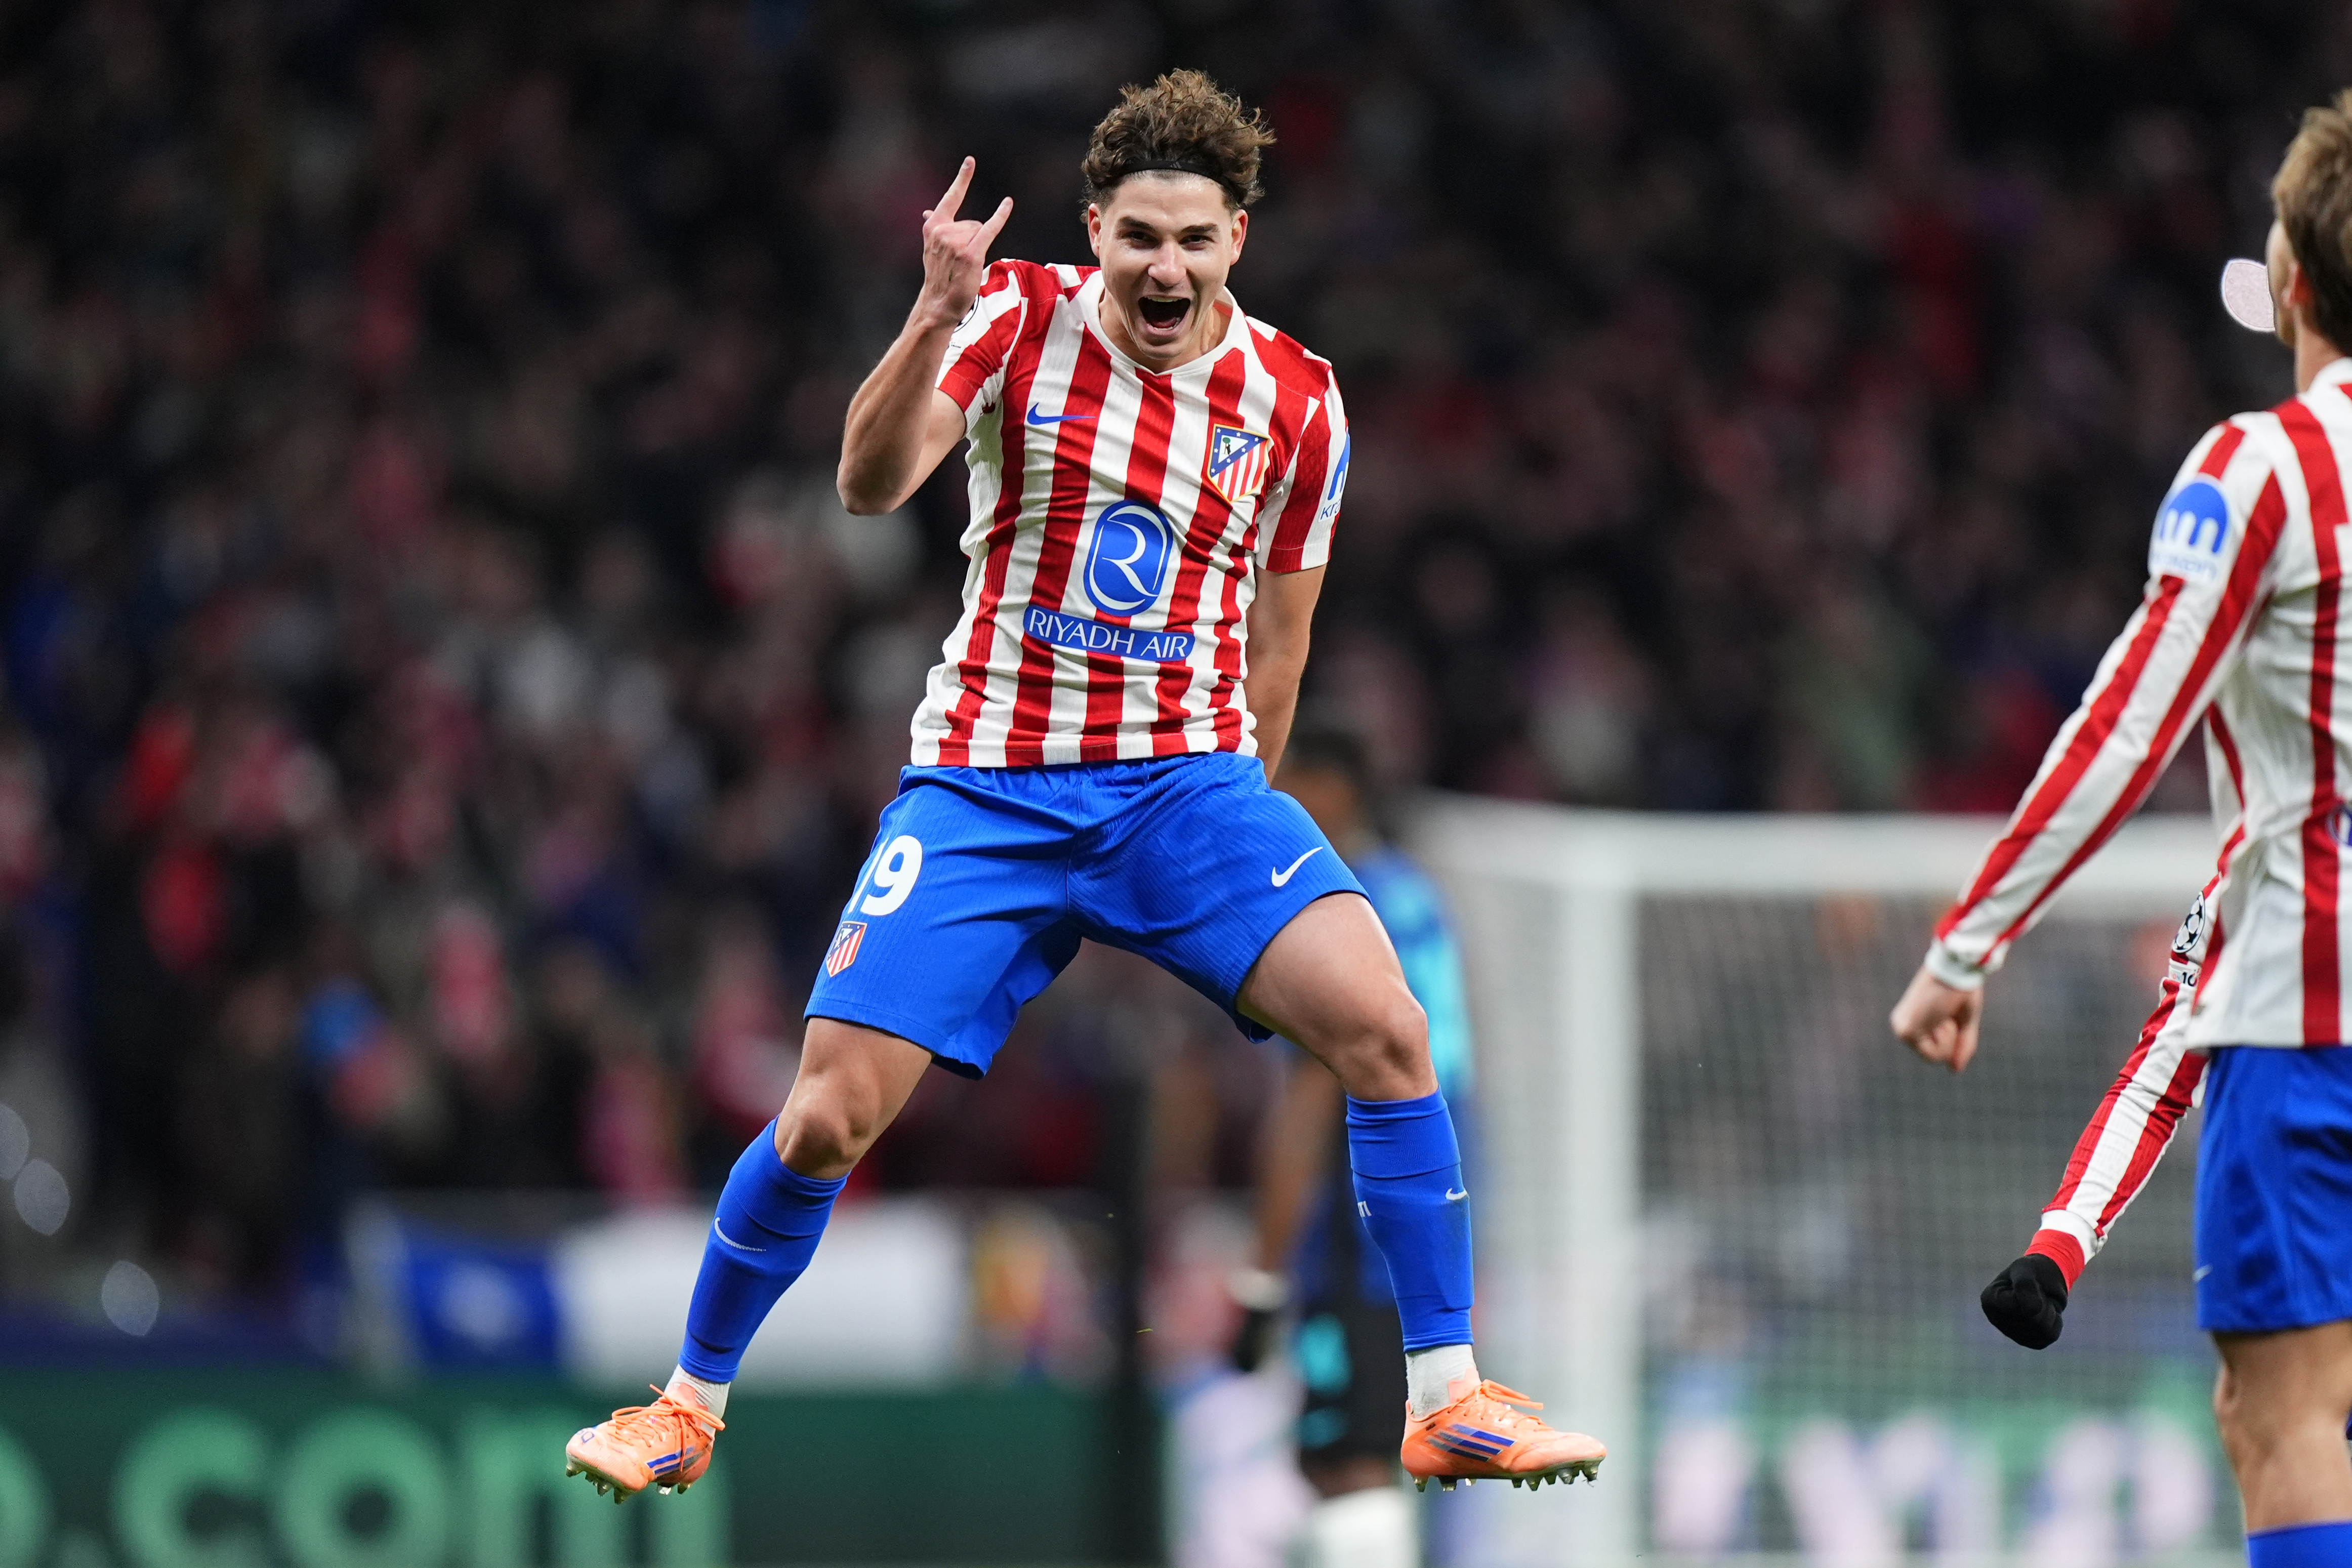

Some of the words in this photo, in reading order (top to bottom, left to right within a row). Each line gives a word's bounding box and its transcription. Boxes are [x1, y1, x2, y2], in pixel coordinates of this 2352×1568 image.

[1089, 505, 1167, 610] R
[1029, 608, 1135, 654] RIYADH
[1140, 635, 1188, 658] AIR
